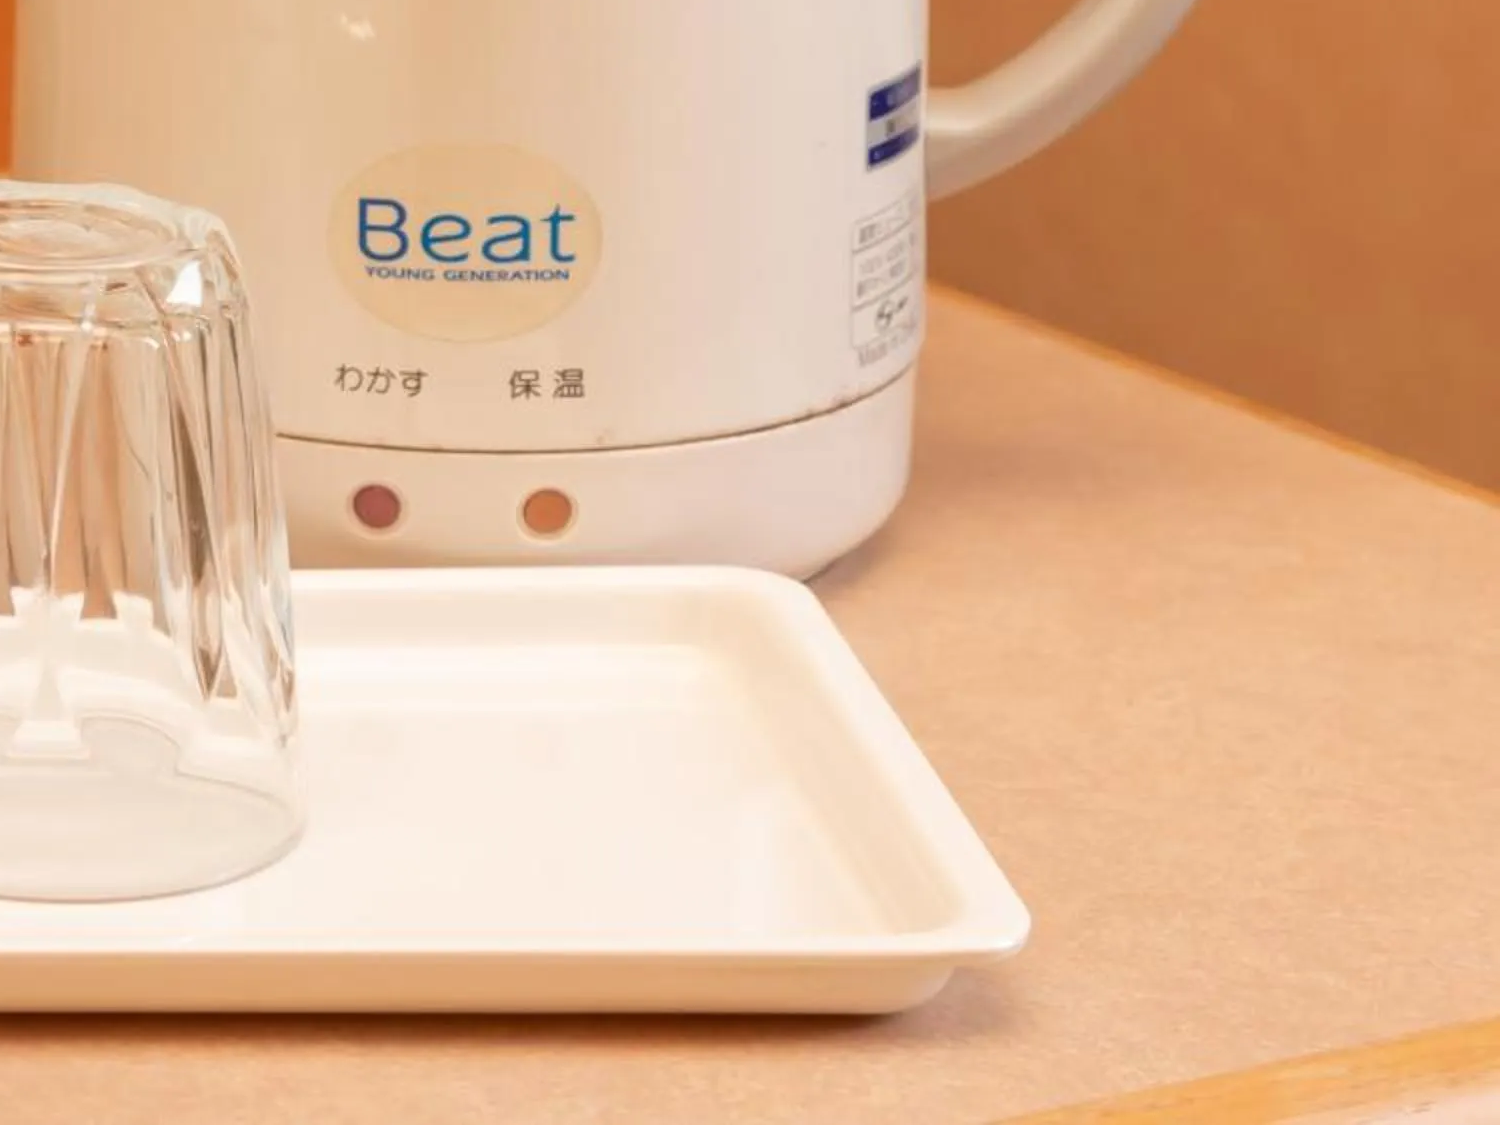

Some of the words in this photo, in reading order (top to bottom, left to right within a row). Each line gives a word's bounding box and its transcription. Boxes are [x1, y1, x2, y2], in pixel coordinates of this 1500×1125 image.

[358, 197, 576, 263] Beat
[365, 266, 435, 282] YOUNG
[443, 268, 570, 282] GENERATION
[334, 364, 429, 398] わかす
